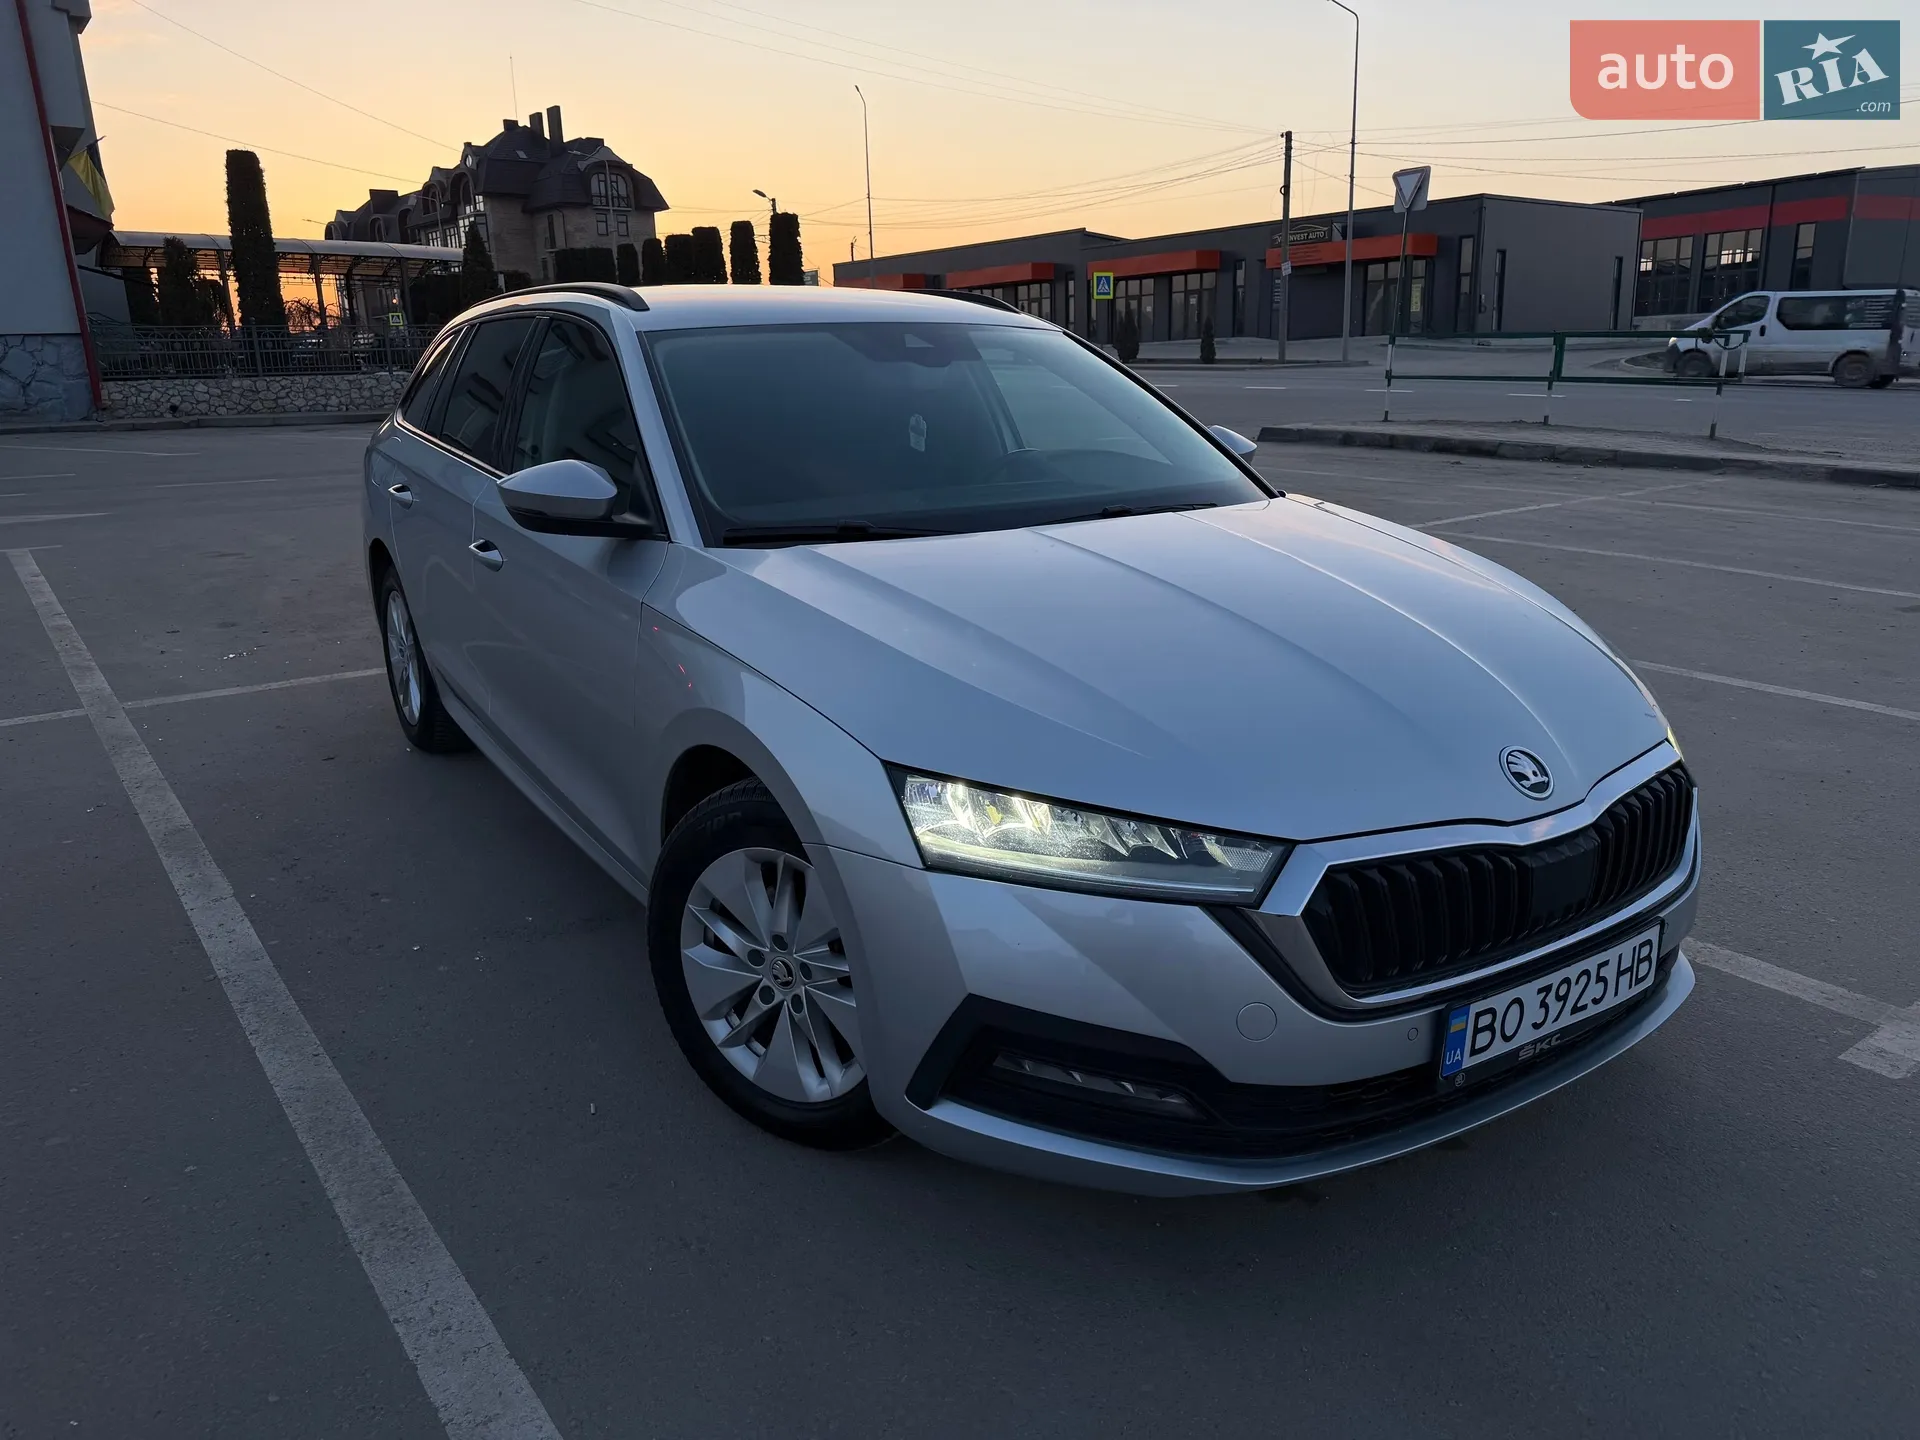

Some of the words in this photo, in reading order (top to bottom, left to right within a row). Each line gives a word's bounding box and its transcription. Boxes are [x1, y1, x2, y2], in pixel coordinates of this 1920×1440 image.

[1288, 233, 1308, 242] NVEST
[1308, 231, 1325, 239] AUTO
[1531, 958, 1610, 1030] 3925
[1445, 1048, 1462, 1065] UA
